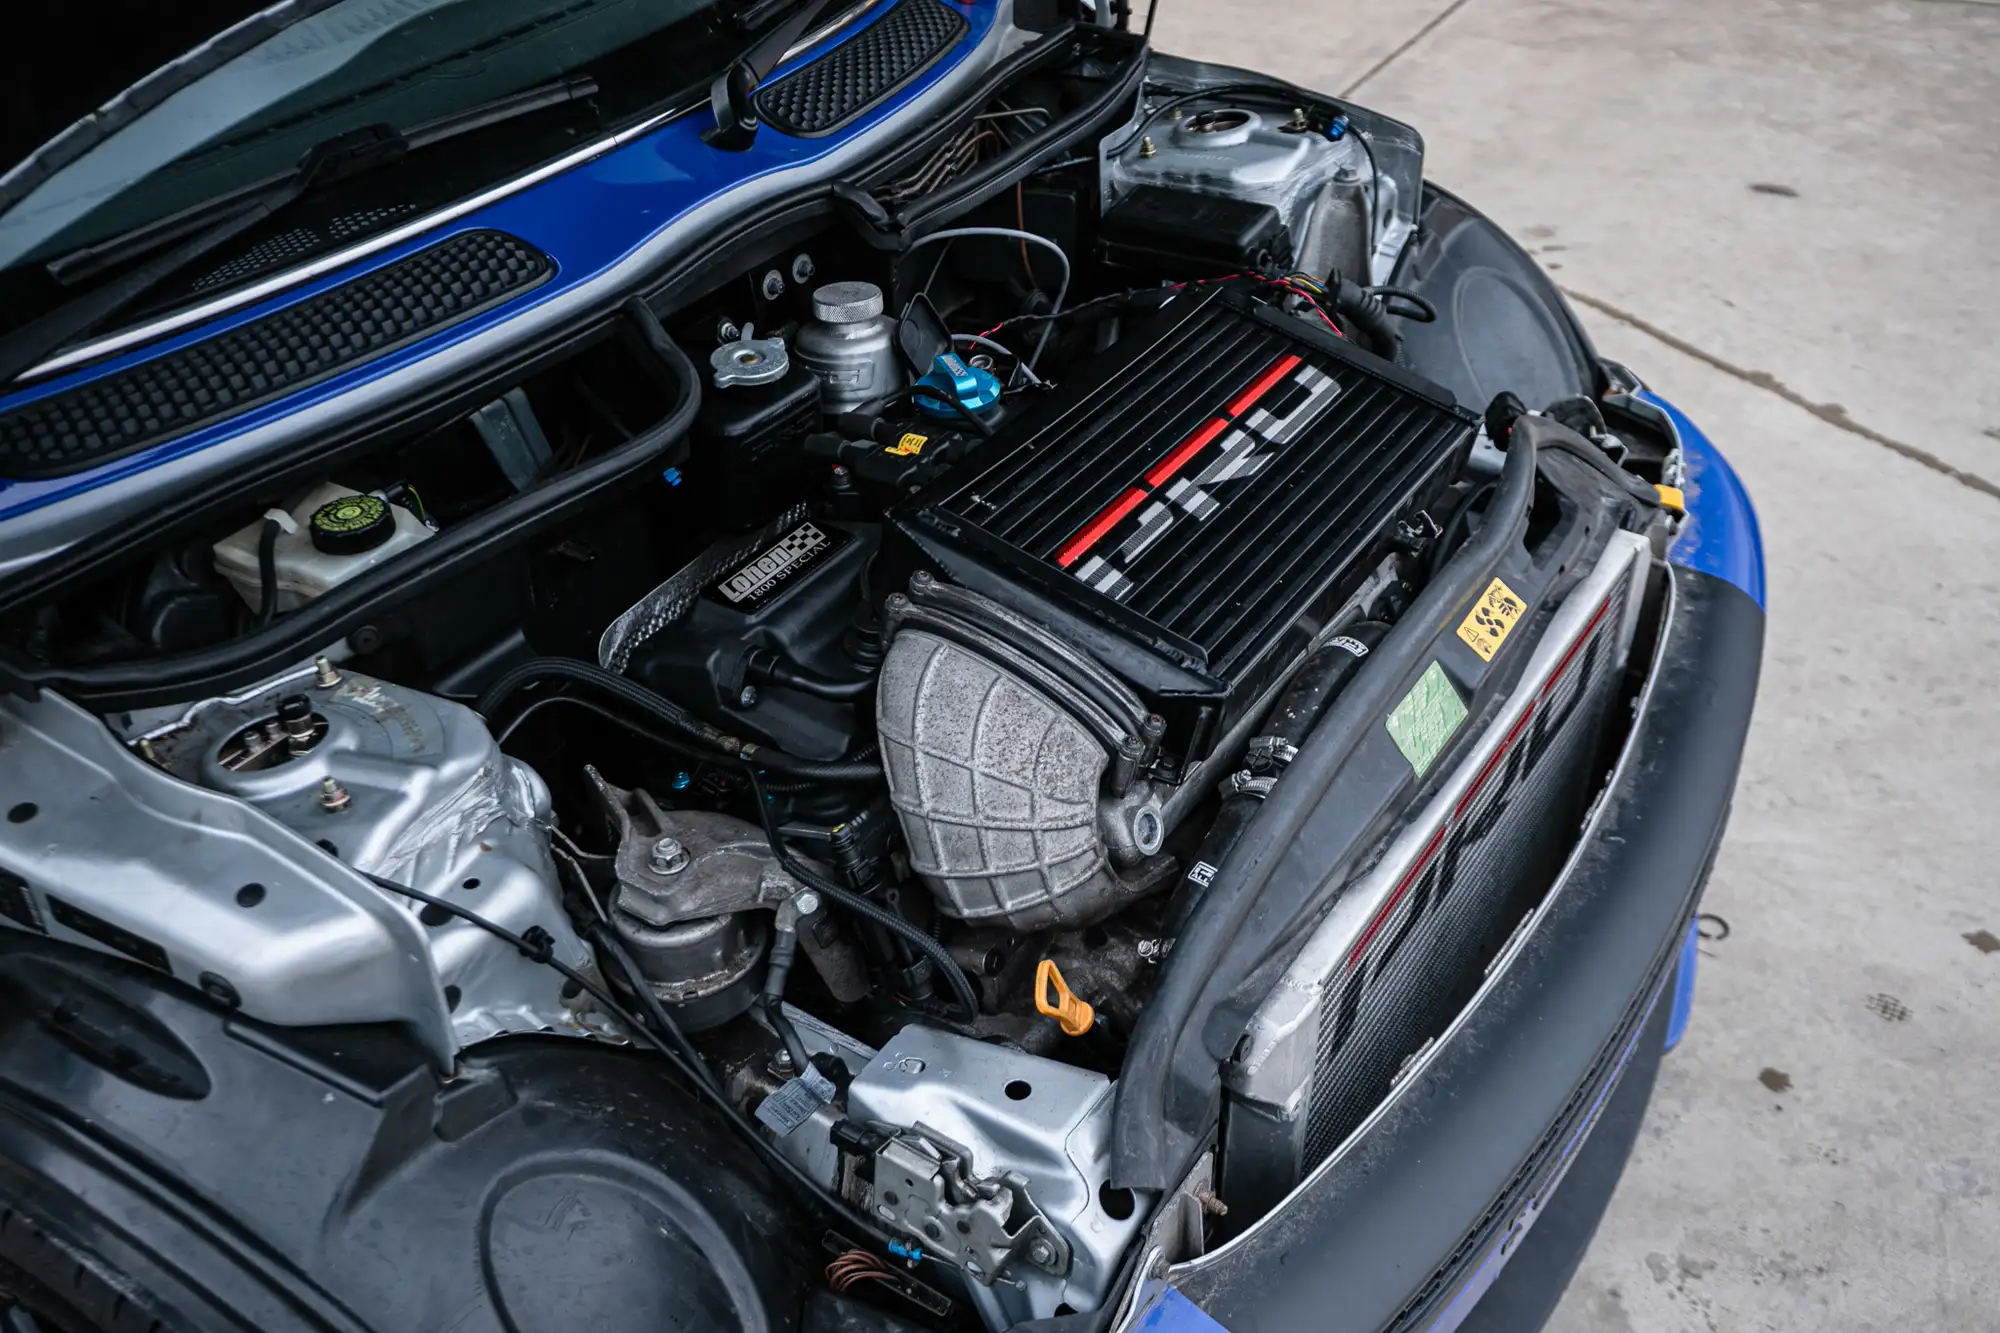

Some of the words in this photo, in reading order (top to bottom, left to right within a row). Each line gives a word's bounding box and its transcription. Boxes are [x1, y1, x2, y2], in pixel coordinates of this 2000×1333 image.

[1056, 355, 1342, 600] PRO
[718, 545, 792, 599] Lohen
[747, 578, 776, 601] 1800
[776, 541, 831, 580] SPECIAL
